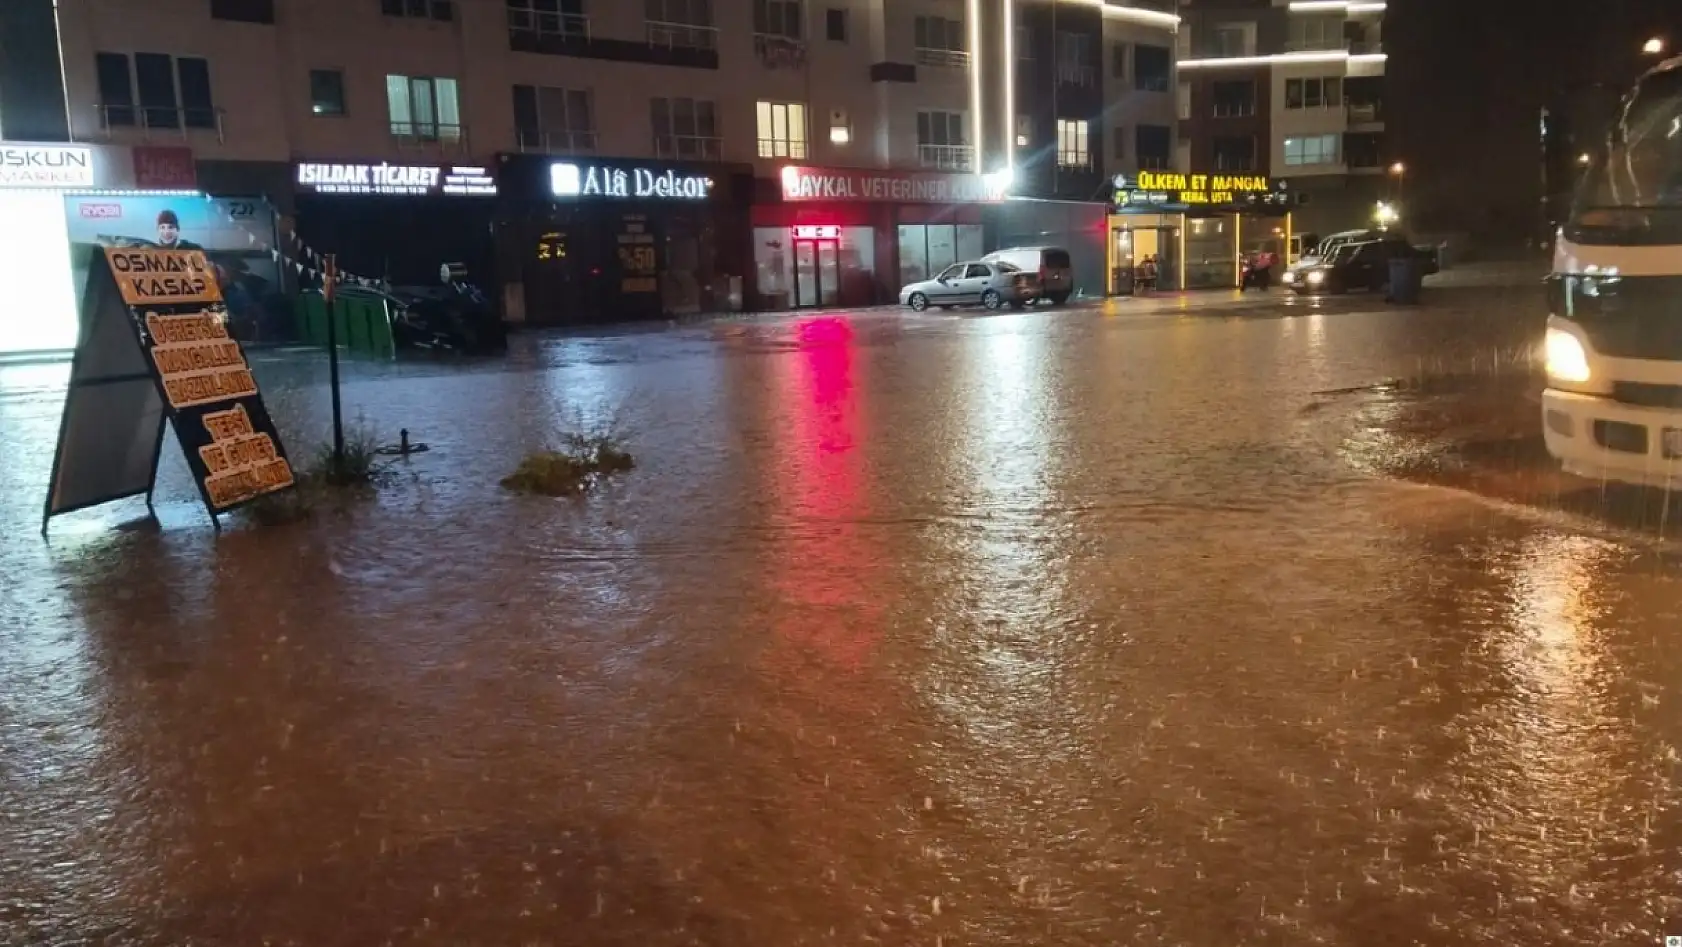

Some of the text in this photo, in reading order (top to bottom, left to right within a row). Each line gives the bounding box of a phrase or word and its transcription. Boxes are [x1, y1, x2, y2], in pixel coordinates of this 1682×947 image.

[0, 150, 86, 167] ŞKUN
[371, 161, 440, 185] TİCARET
[632, 167, 712, 197] Dekor
[1191, 175, 1208, 190] ET
[1213, 176, 1268, 191] MANGAL
[132, 278, 208, 297] KASAP
